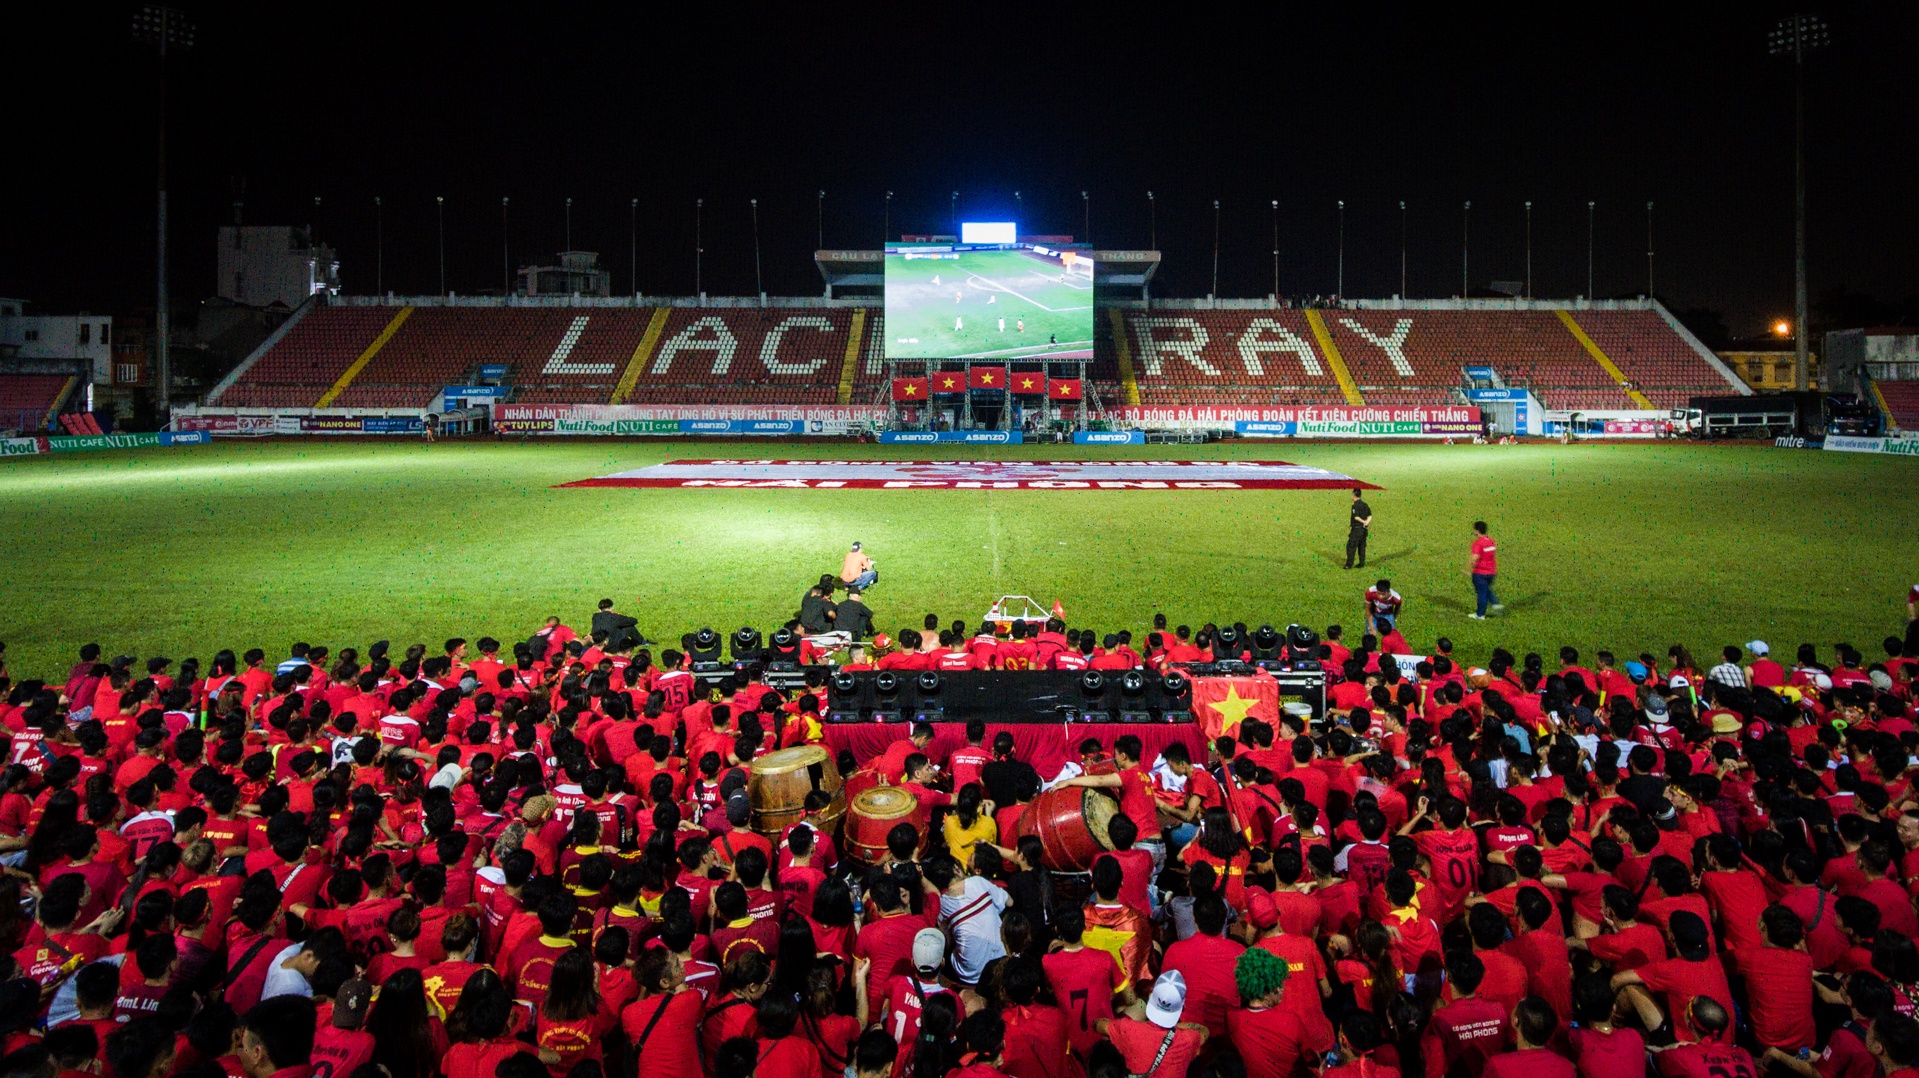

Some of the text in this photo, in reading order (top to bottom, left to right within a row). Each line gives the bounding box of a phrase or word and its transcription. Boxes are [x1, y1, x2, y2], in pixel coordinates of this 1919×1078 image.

[504, 406, 533, 420] NHÂN
[535, 406, 556, 420] DÂN
[618, 408, 653, 420] CHUNG
[655, 408, 678, 420] TAY
[747, 406, 774, 420] PHÁT
[775, 404, 804, 420] TRIỂN
[807, 406, 834, 420] BÓNG
[837, 406, 851, 420] ĐÁ
[1143, 407, 1175, 421] BÓNG
[1178, 407, 1193, 421] ĐÁ
[1198, 406, 1217, 421] HẢI
[1220, 407, 1258, 422] PHÒNG
[1262, 407, 1294, 422] ĐOÀN
[1298, 406, 1318, 422] KẾT
[1322, 408, 1348, 422] KIÊN
[1393, 406, 1428, 422] CHIẾN
[511, 421, 554, 430] TUYLIPS
[556, 420, 615, 432] NutiFood
[618, 421, 654, 431] NUTI
[691, 421, 728, 430] Asanzo
[753, 421, 790, 430] Asanzo
[1246, 423, 1282, 431] Asanzo
[1300, 421, 1357, 433] NutiFood
[1360, 423, 1395, 433] NUTI
[105, 435, 139, 448] NUTI
[894, 433, 935, 441] Asanzo
[965, 433, 1006, 441] Asanzo
[1086, 434, 1127, 442] Asanzo
[1775, 435, 1805, 448] mitre
[50, 439, 78, 449] NUTI
[664, 684, 684, 704] 15
[14, 741, 31, 765] 7
[1448, 857, 1477, 890] 01
[1288, 962, 1304, 972] NAM
[1070, 987, 1089, 1033] 7
